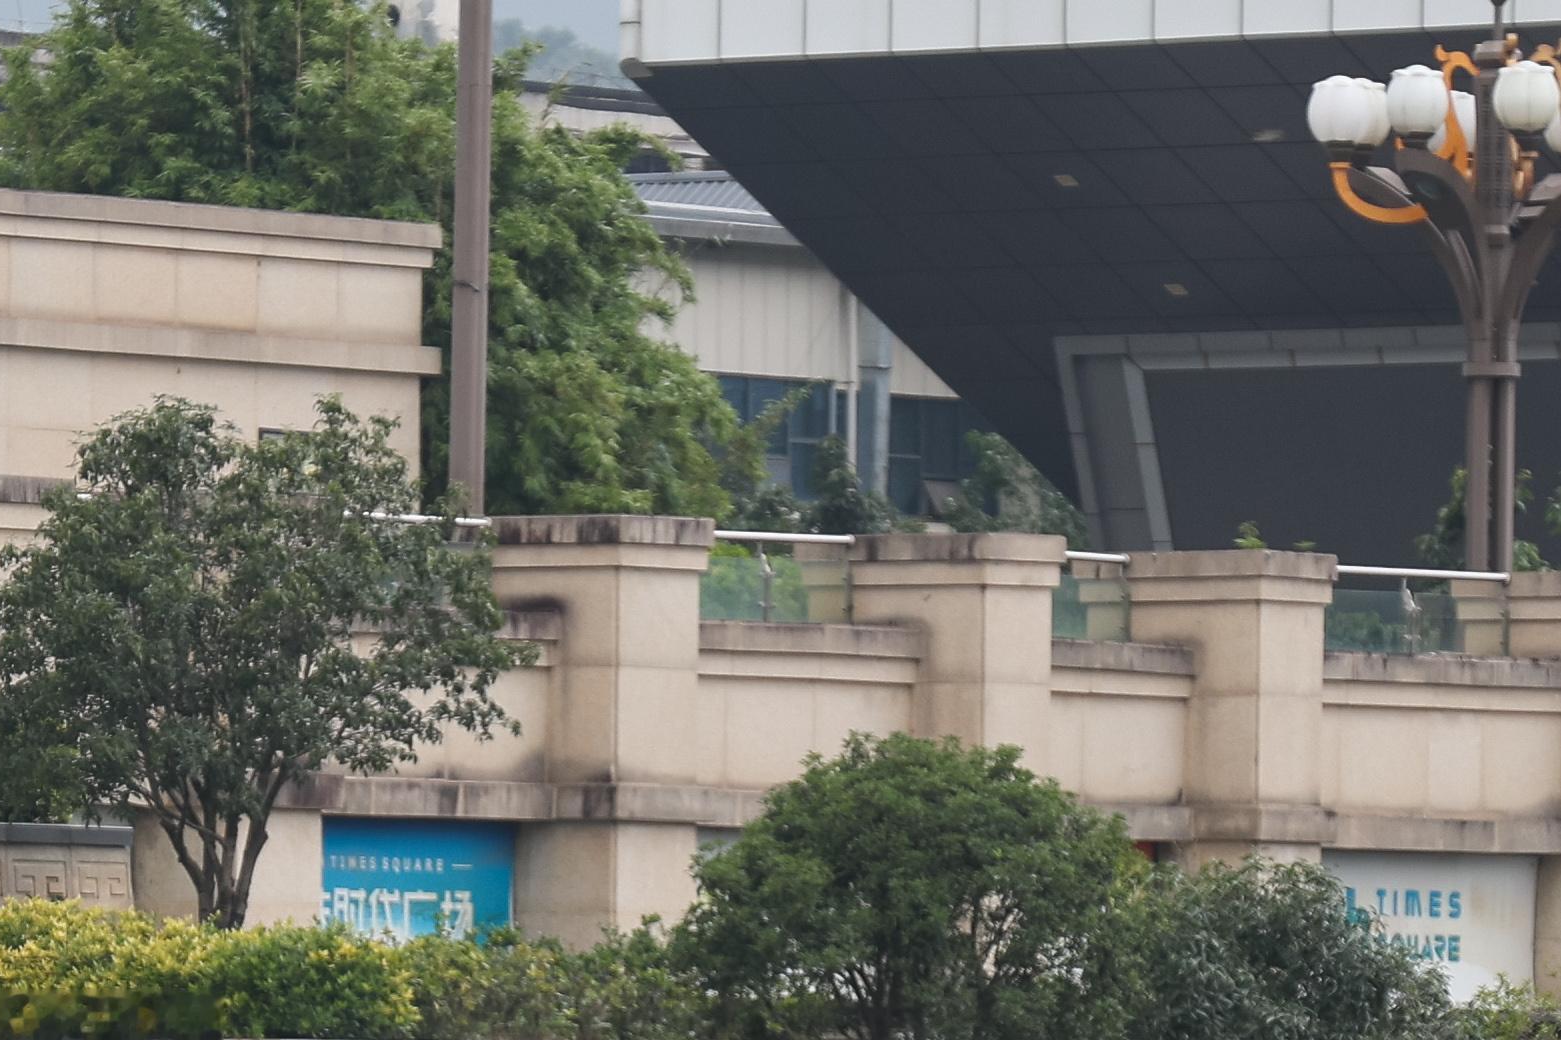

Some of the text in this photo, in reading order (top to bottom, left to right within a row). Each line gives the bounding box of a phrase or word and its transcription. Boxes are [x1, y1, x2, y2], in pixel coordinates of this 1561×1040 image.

[330, 855, 445, 873] TIMES SQUARE
[1376, 888, 1462, 919] TIMES
